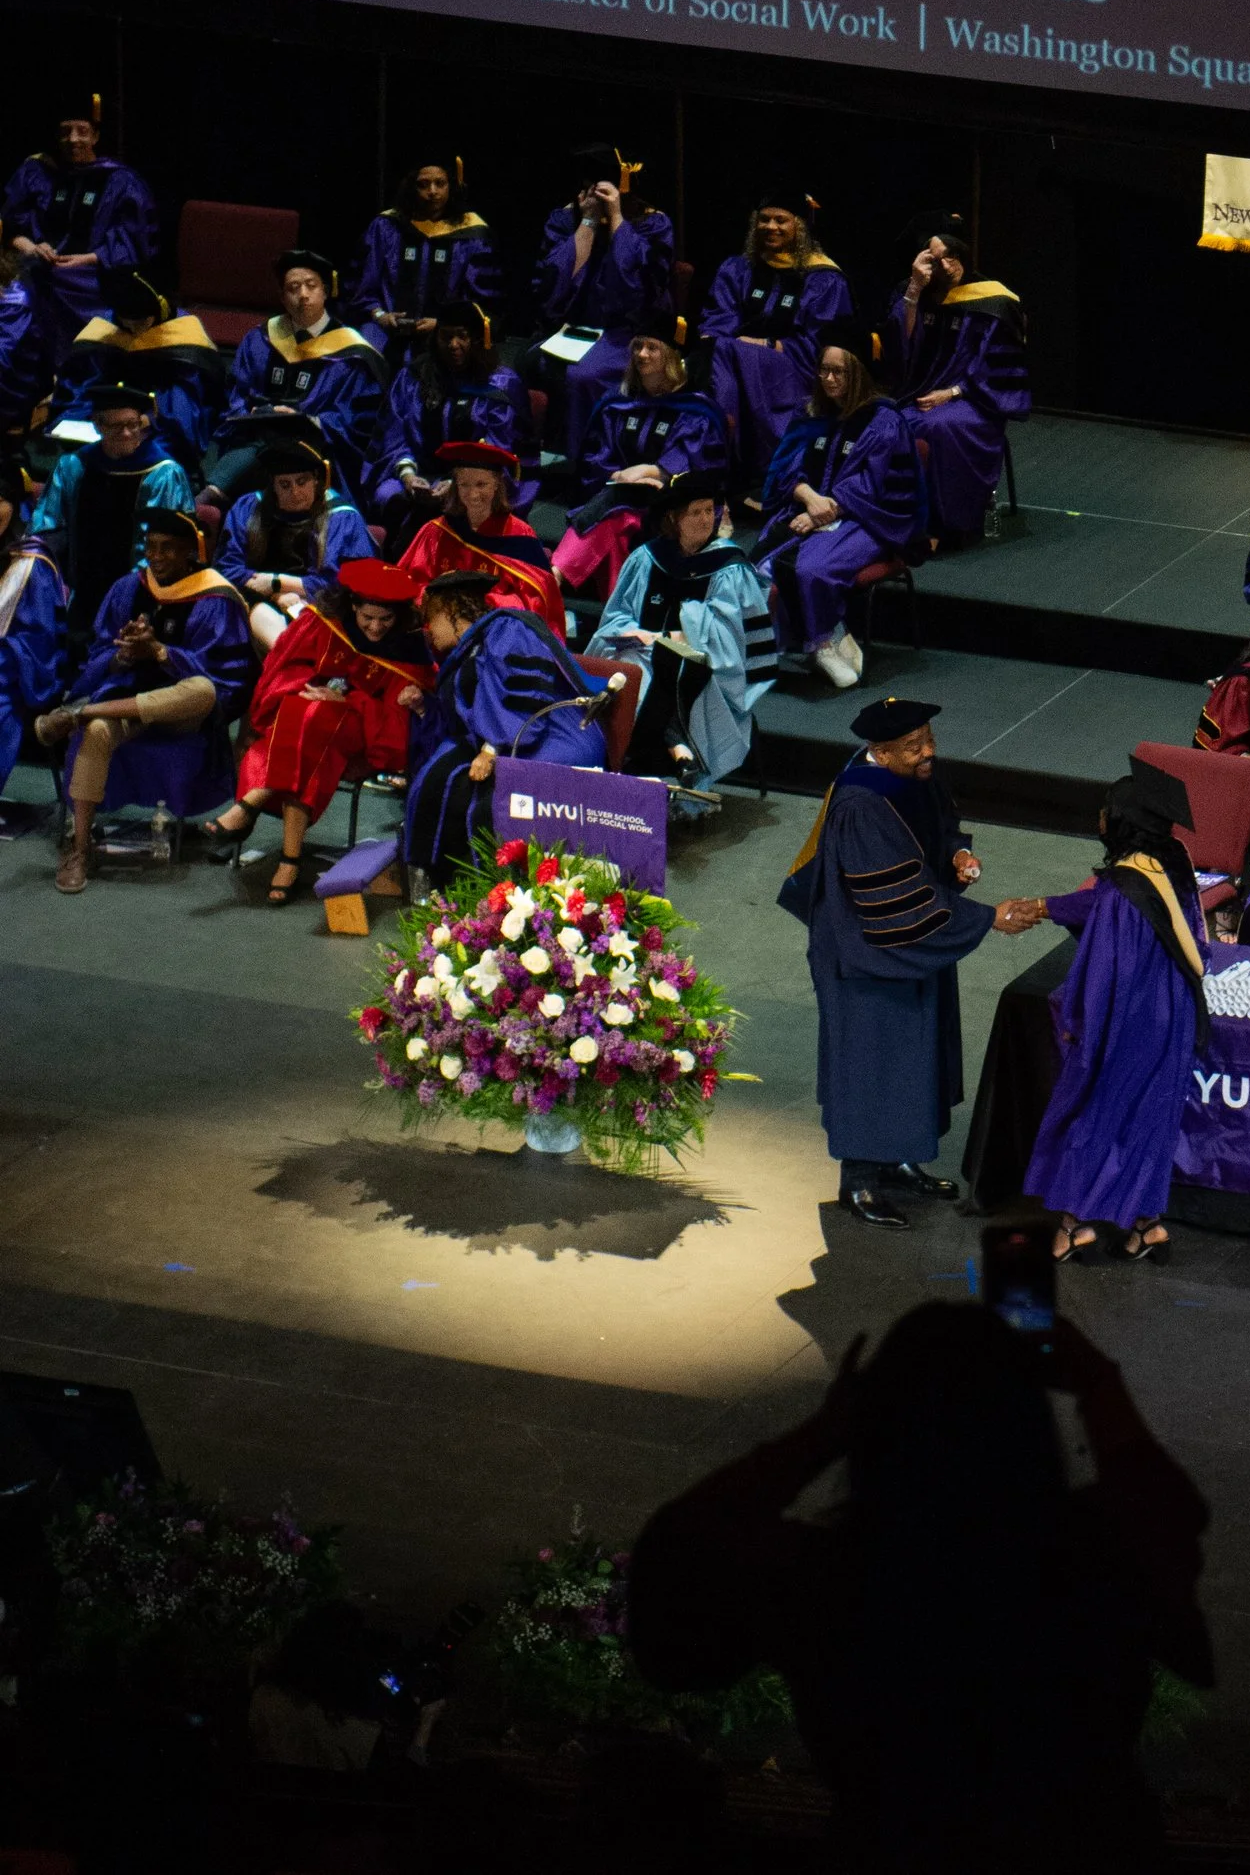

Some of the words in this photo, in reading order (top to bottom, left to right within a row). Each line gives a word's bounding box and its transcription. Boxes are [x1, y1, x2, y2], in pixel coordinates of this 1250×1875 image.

[800, 0, 898, 42] Work
[945, 17, 1157, 75] Washington
[537, 801, 578, 821] NYU
[586, 808, 613, 819] SILVER
[614, 812, 646, 825] SCHOOL
[586, 815, 598, 824] OF
[599, 817, 626, 830] SOCIAL
[627, 824, 653, 834] WORK
[1192, 1069, 1250, 1109] YU
